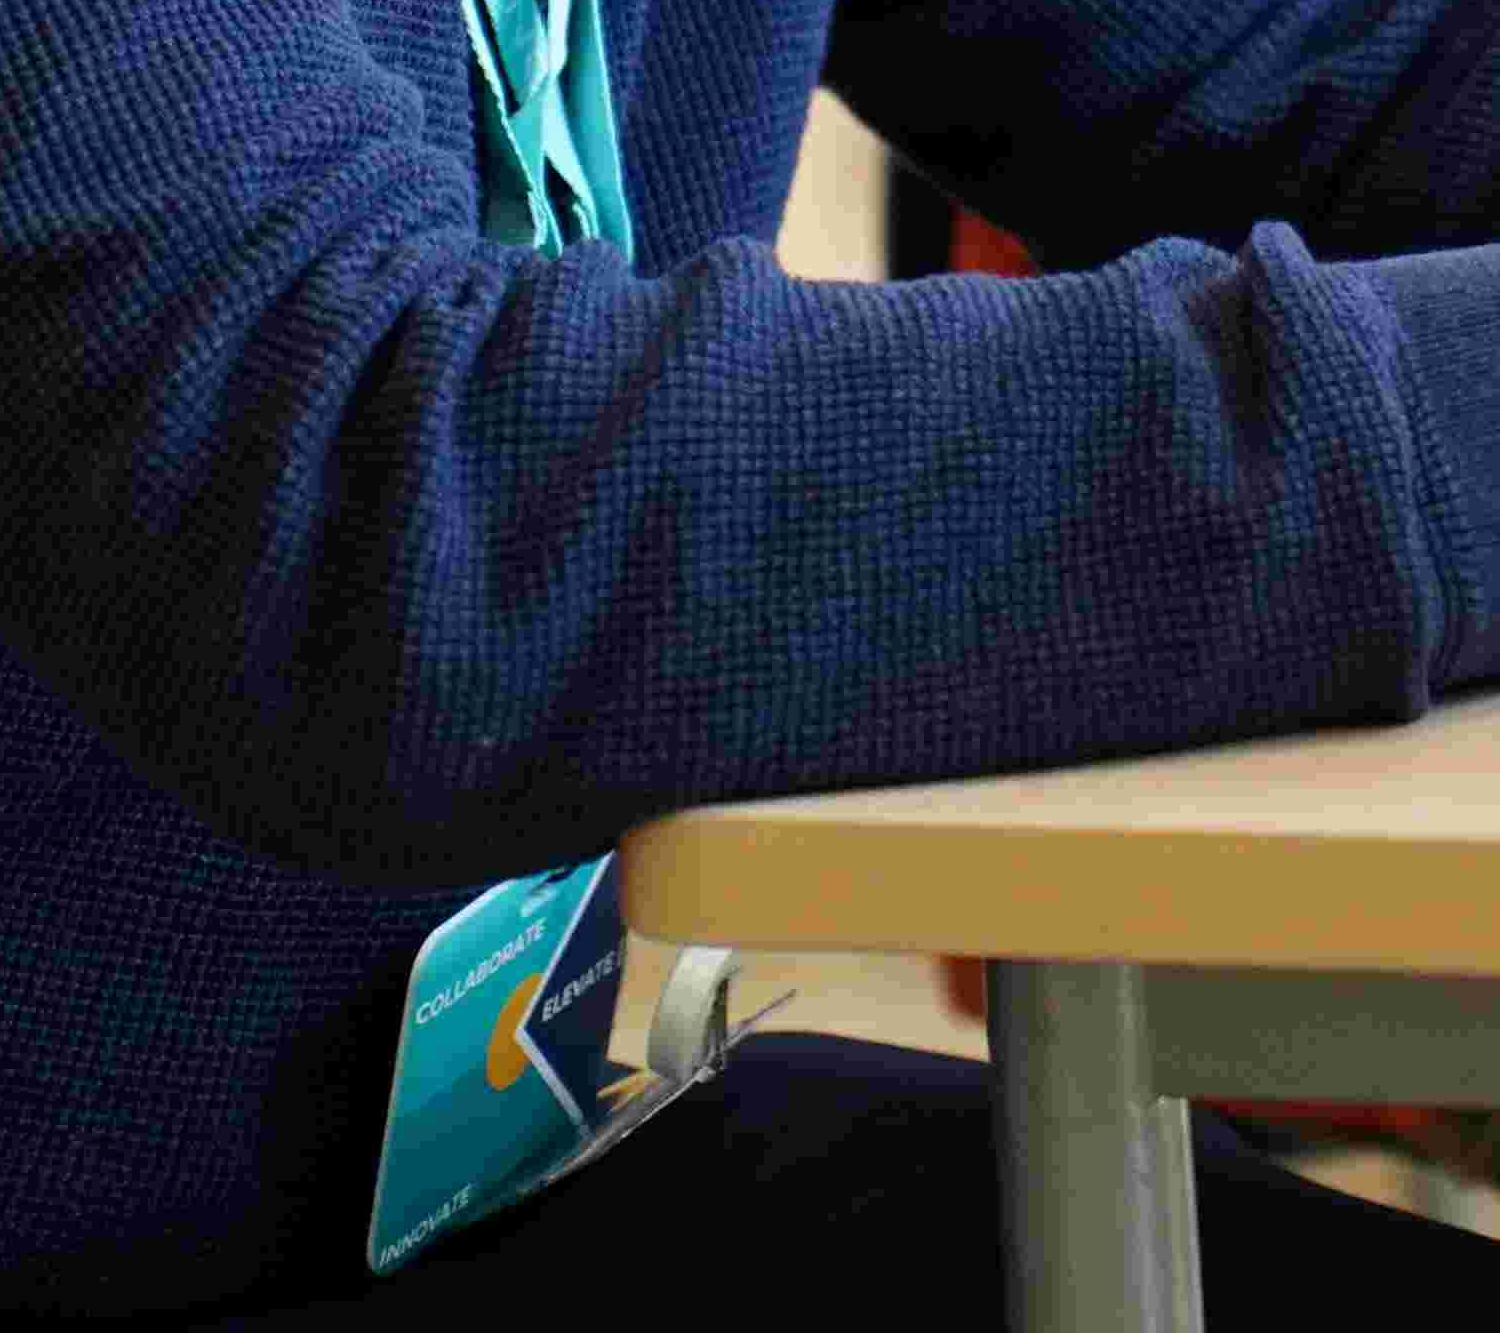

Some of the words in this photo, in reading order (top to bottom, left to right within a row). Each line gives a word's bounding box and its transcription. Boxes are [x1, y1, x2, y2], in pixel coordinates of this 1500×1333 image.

[415, 917, 548, 1025] COLLABORATE
[541, 949, 616, 1023] ELEVATE
[379, 1181, 471, 1270] INNOVATE
